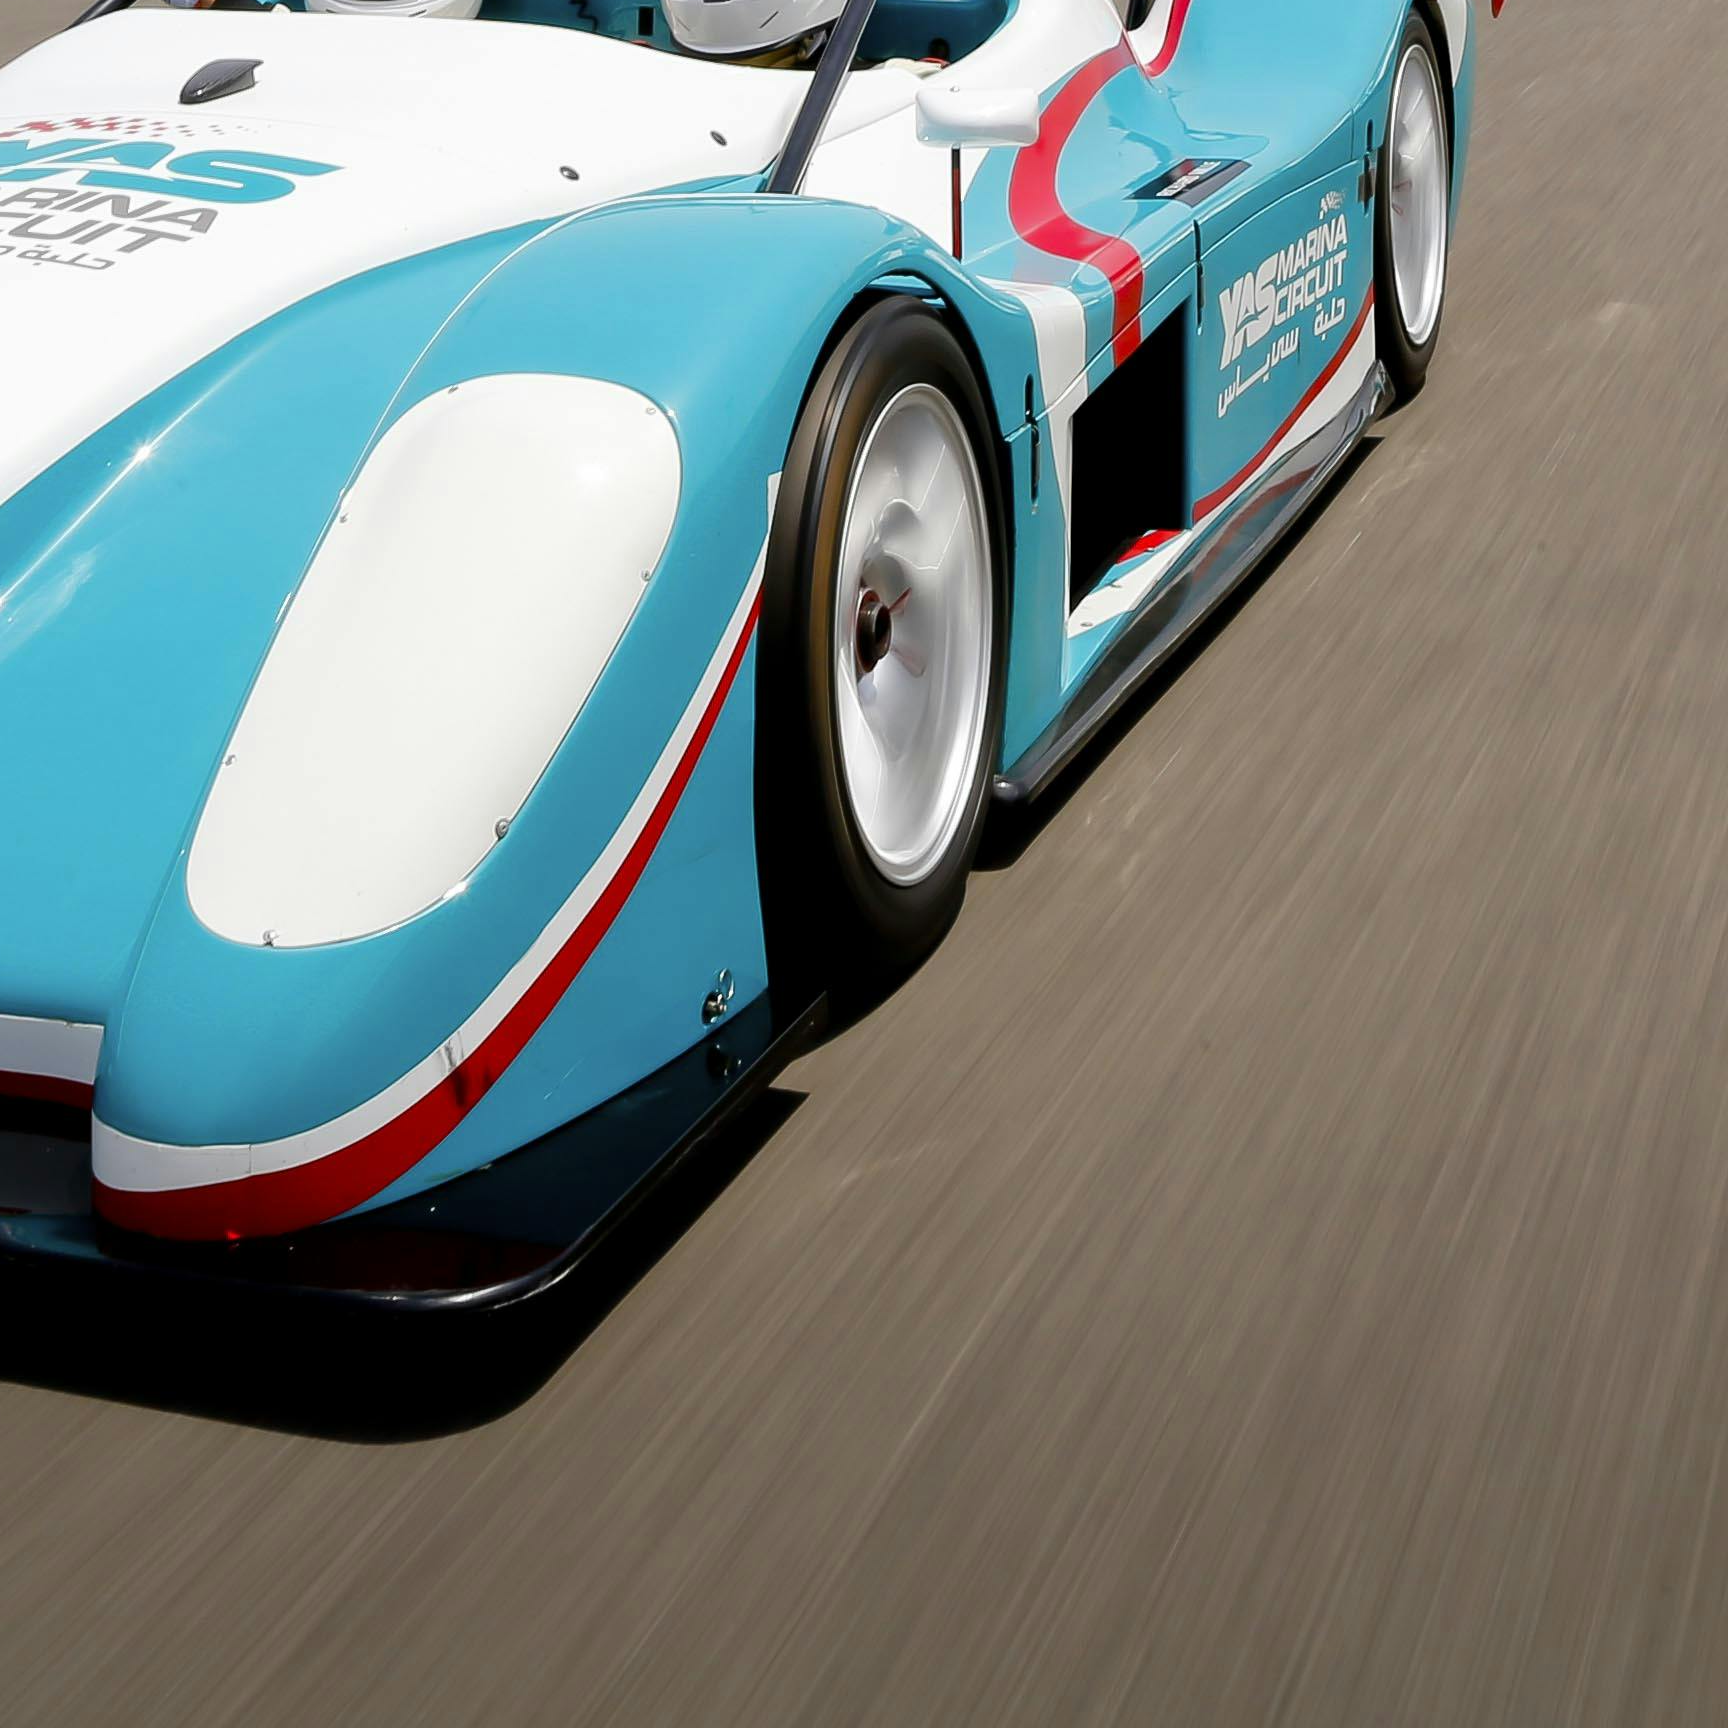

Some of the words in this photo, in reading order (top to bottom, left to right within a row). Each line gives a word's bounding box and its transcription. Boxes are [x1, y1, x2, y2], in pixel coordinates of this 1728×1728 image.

[16, 244, 116, 270] حلبة
[1218, 252, 1279, 371] YAS
[1276, 213, 1348, 296] MARINA
[1273, 249, 1348, 326] CIRCUIT
